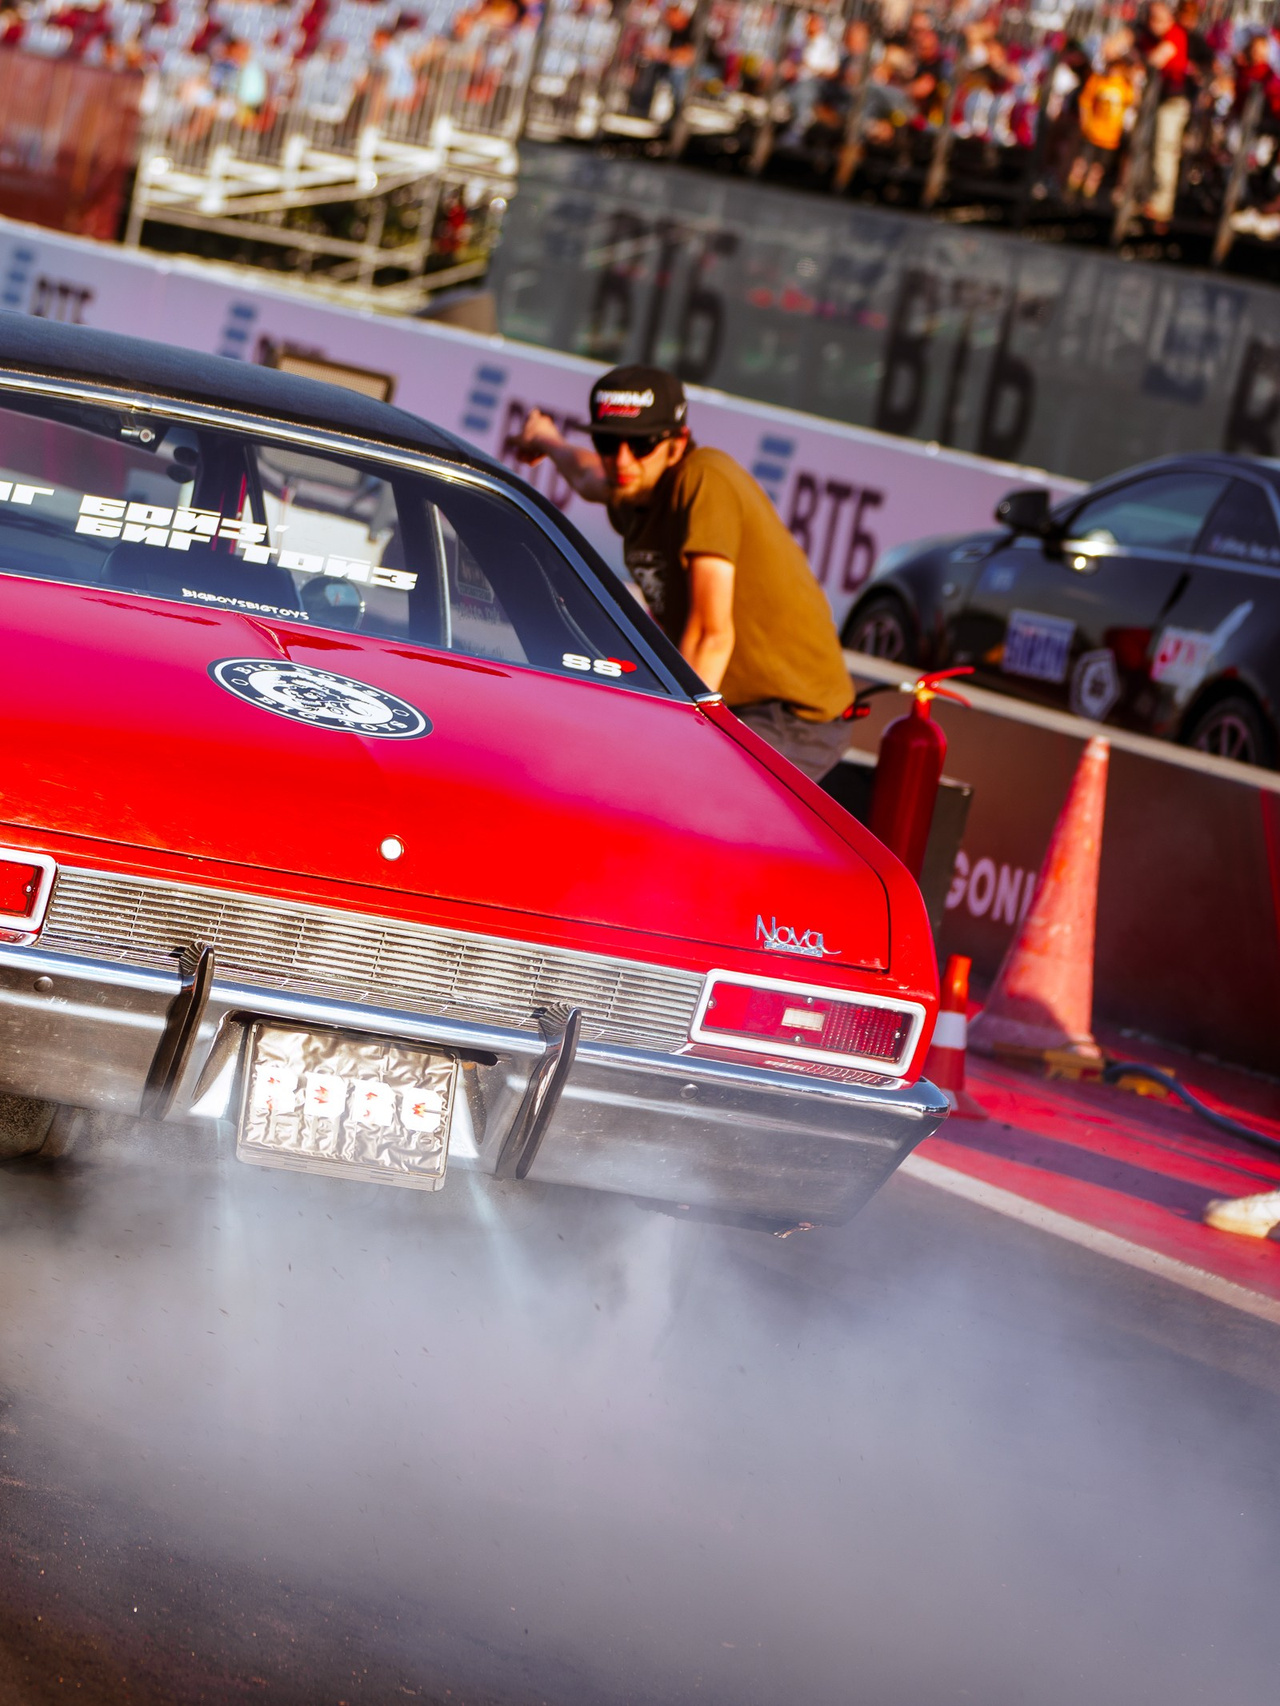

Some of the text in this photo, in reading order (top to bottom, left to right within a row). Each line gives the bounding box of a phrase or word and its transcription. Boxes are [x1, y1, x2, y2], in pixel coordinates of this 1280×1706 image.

[786, 469, 888, 596] ВТБ
[74, 515, 212, 551] БИГ
[239, 542, 419, 591] ТОЙЗ
[233, 663, 278, 675] BIG
[562, 652, 623, 678] SS
[255, 696, 408, 733] BIG TOYS
[755, 914, 842, 955] Nova
